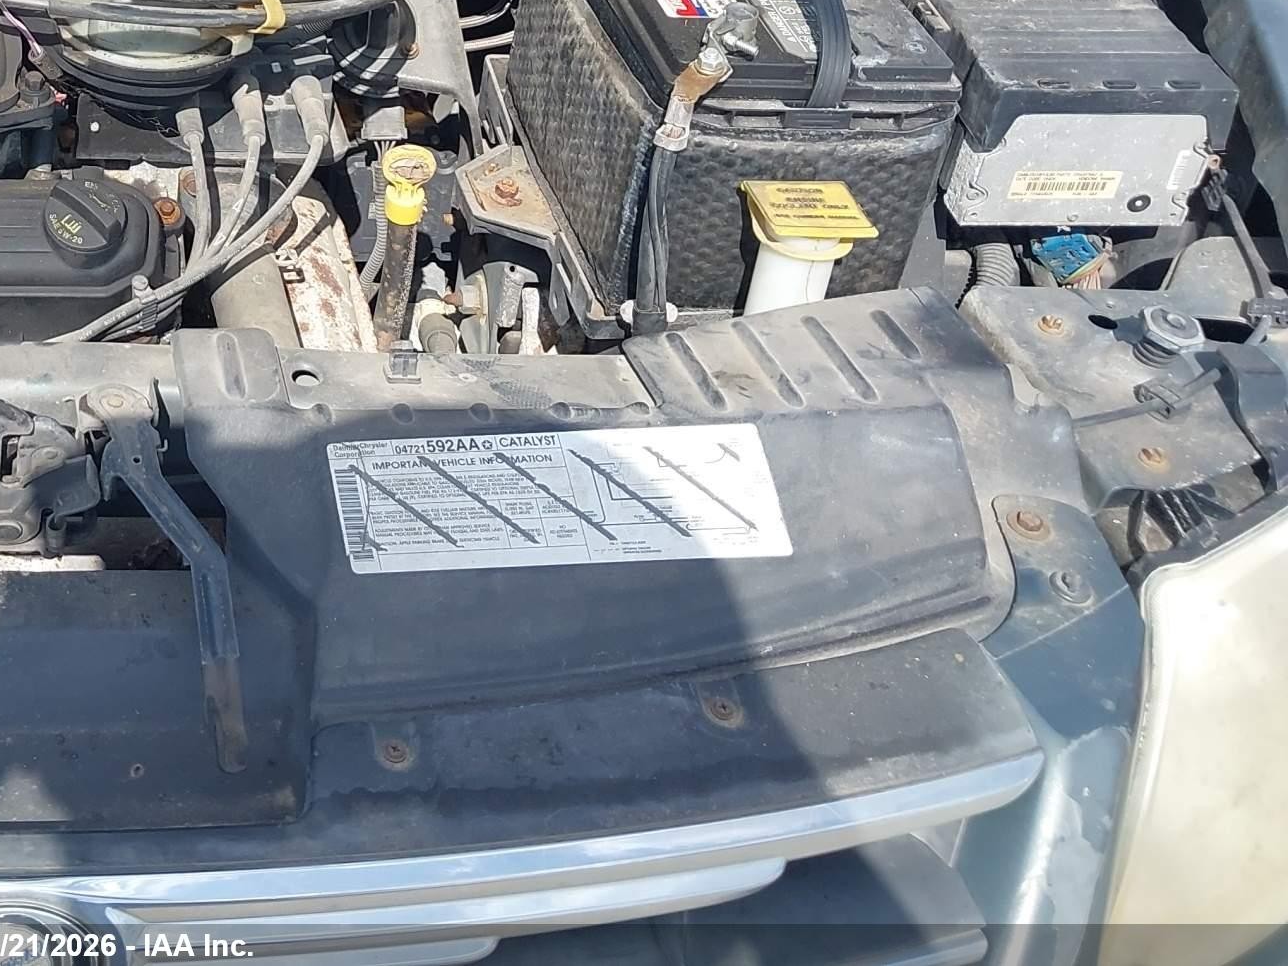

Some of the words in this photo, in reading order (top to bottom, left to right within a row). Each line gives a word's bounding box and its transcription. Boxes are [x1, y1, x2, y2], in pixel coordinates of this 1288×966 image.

[394, 437, 480, 454] 04721592AA
[499, 435, 556, 447] CATALYST
[372, 459, 434, 470] IMPORTAN
[435, 456, 477, 467] VEHICLE
[478, 454, 553, 465] INFOMATION
